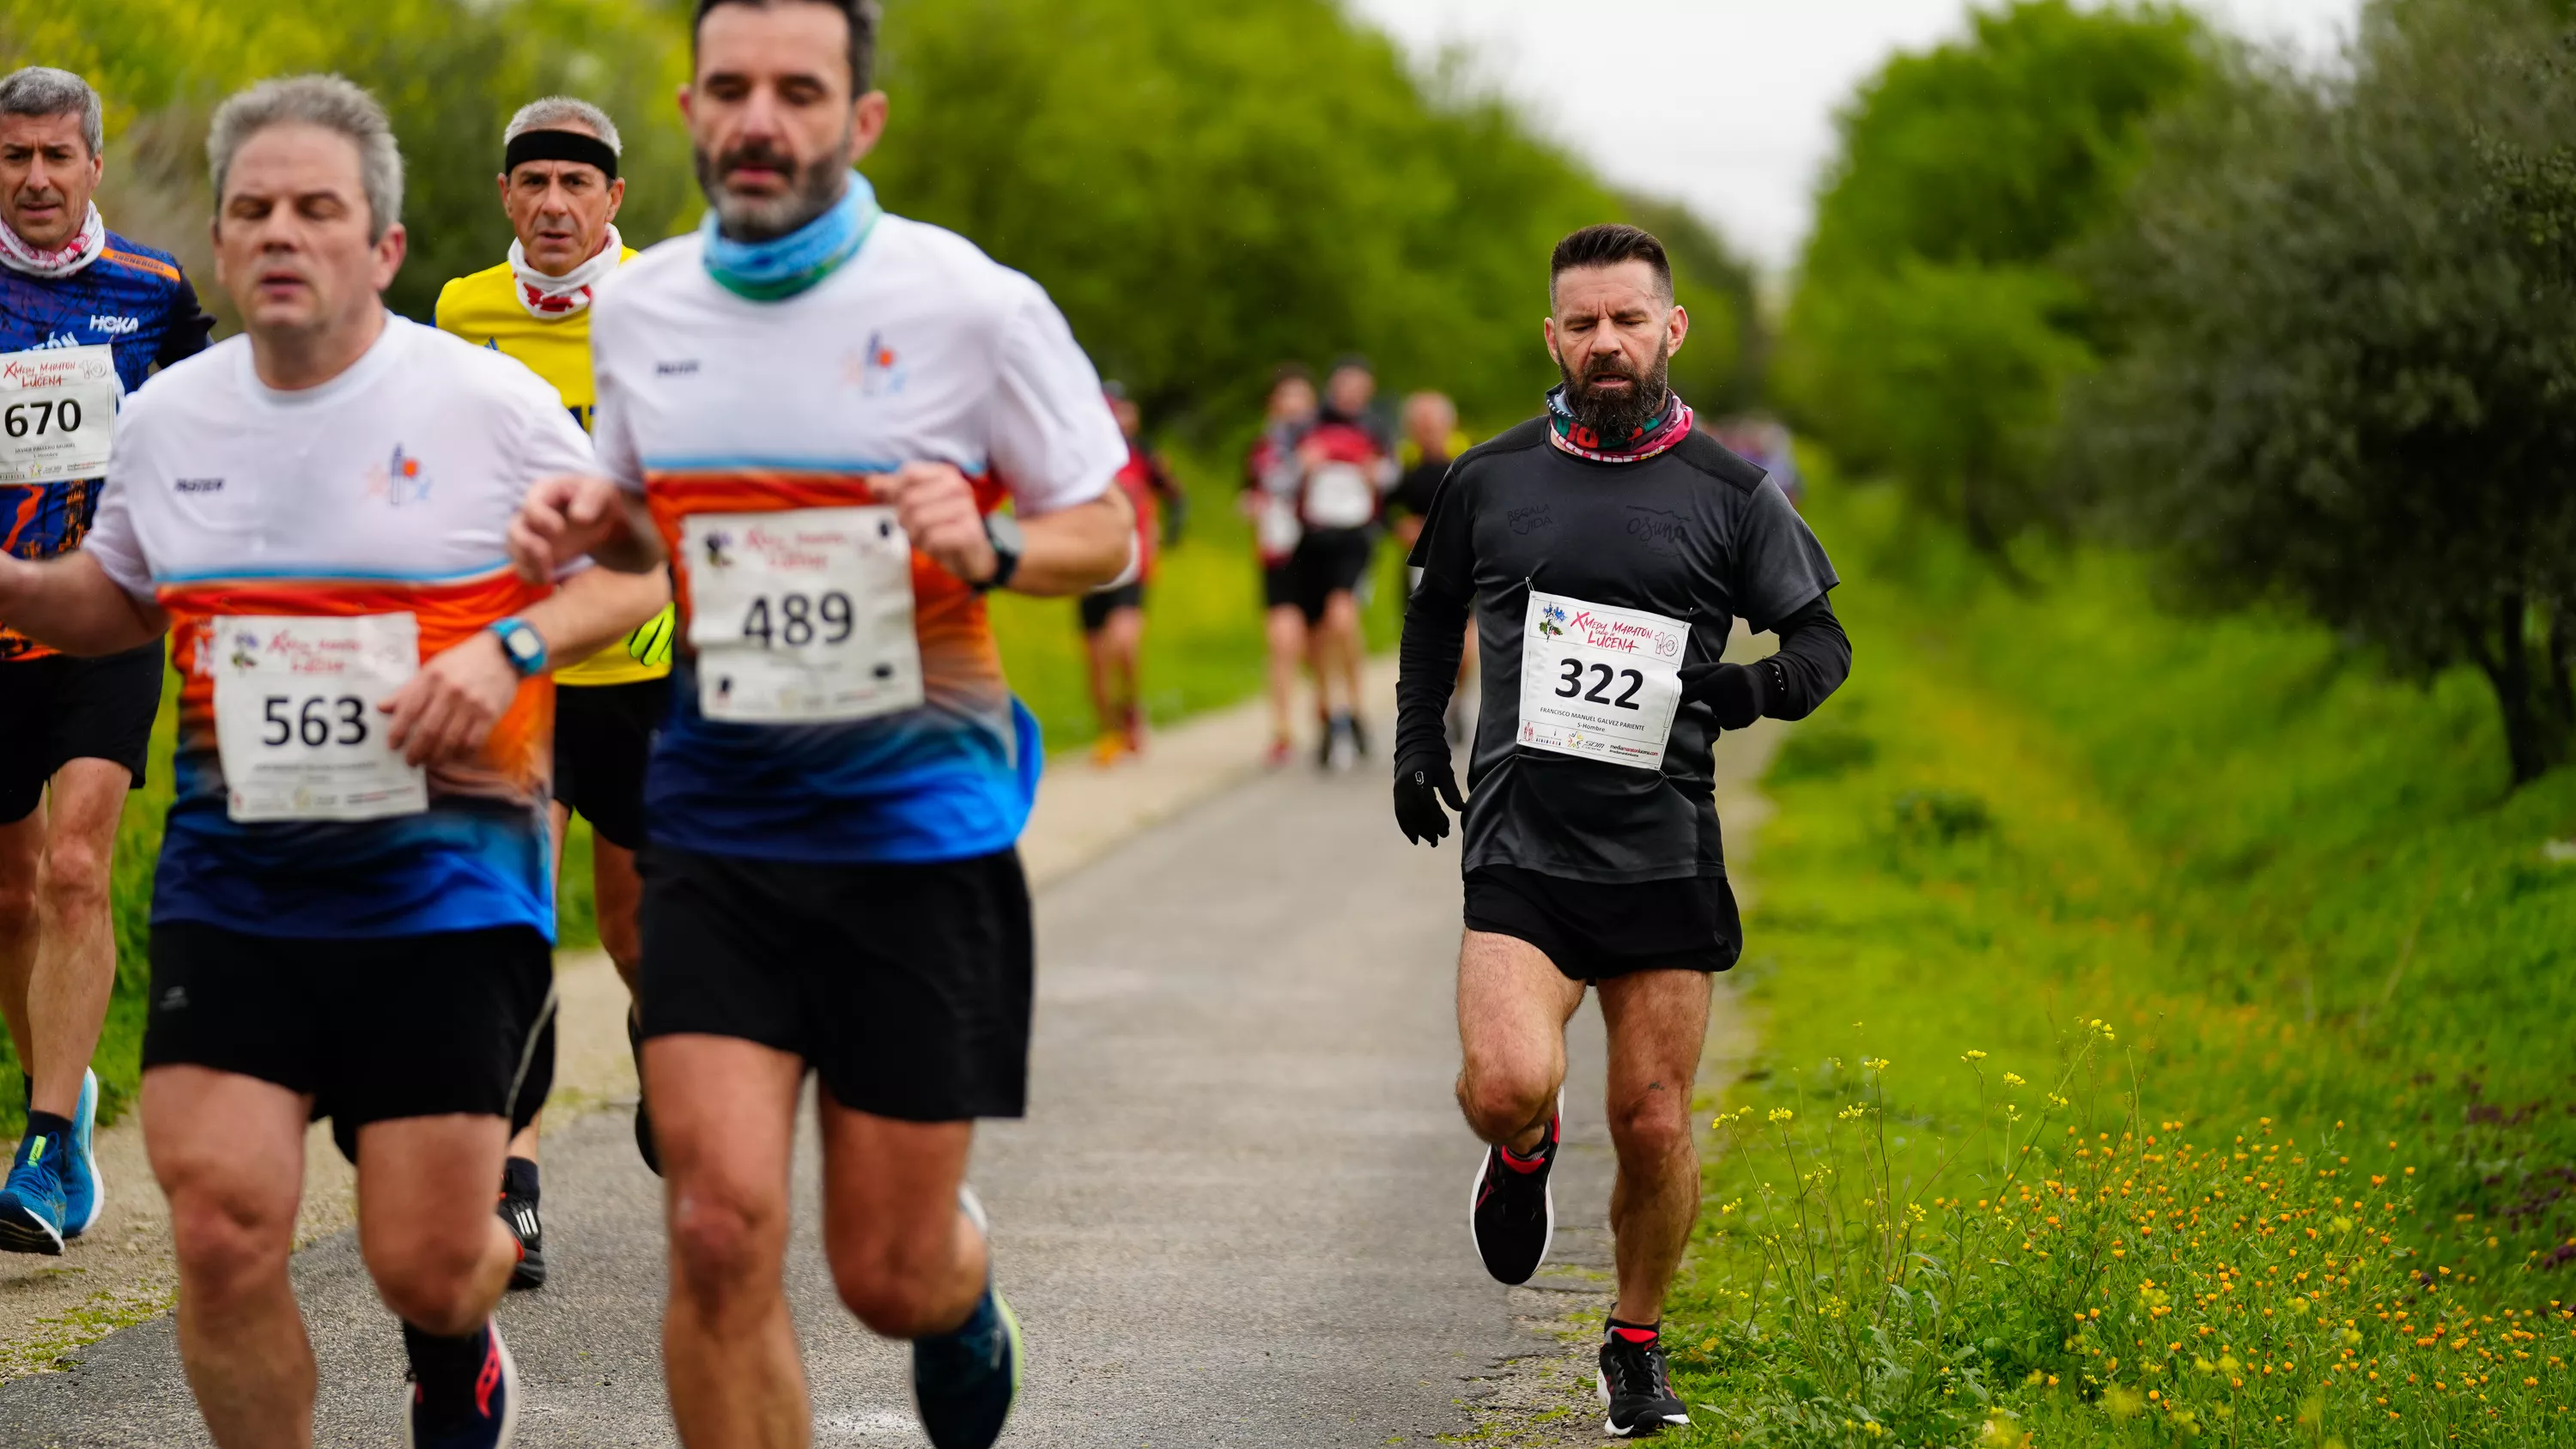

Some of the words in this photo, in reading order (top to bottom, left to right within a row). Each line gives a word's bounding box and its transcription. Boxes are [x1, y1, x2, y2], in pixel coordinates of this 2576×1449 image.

[88, 314, 139, 334] HOKA
[22, 374, 66, 388] LUCENA
[4, 397, 82, 438] 670
[1508, 504, 1551, 519] REGALA
[743, 591, 854, 650] 489
[1570, 611, 1590, 633] X
[1612, 621, 1654, 639] MARATÓN
[1587, 631, 1639, 652] LUCENA
[1555, 658, 1643, 710] 322
[262, 695, 368, 747] 563
[1540, 706, 1571, 718] FRANCISCO
[1571, 712, 1596, 723] MANUEL
[1597, 717, 1619, 726] GALVEZ
[1619, 721, 1645, 731] PARIENTE
